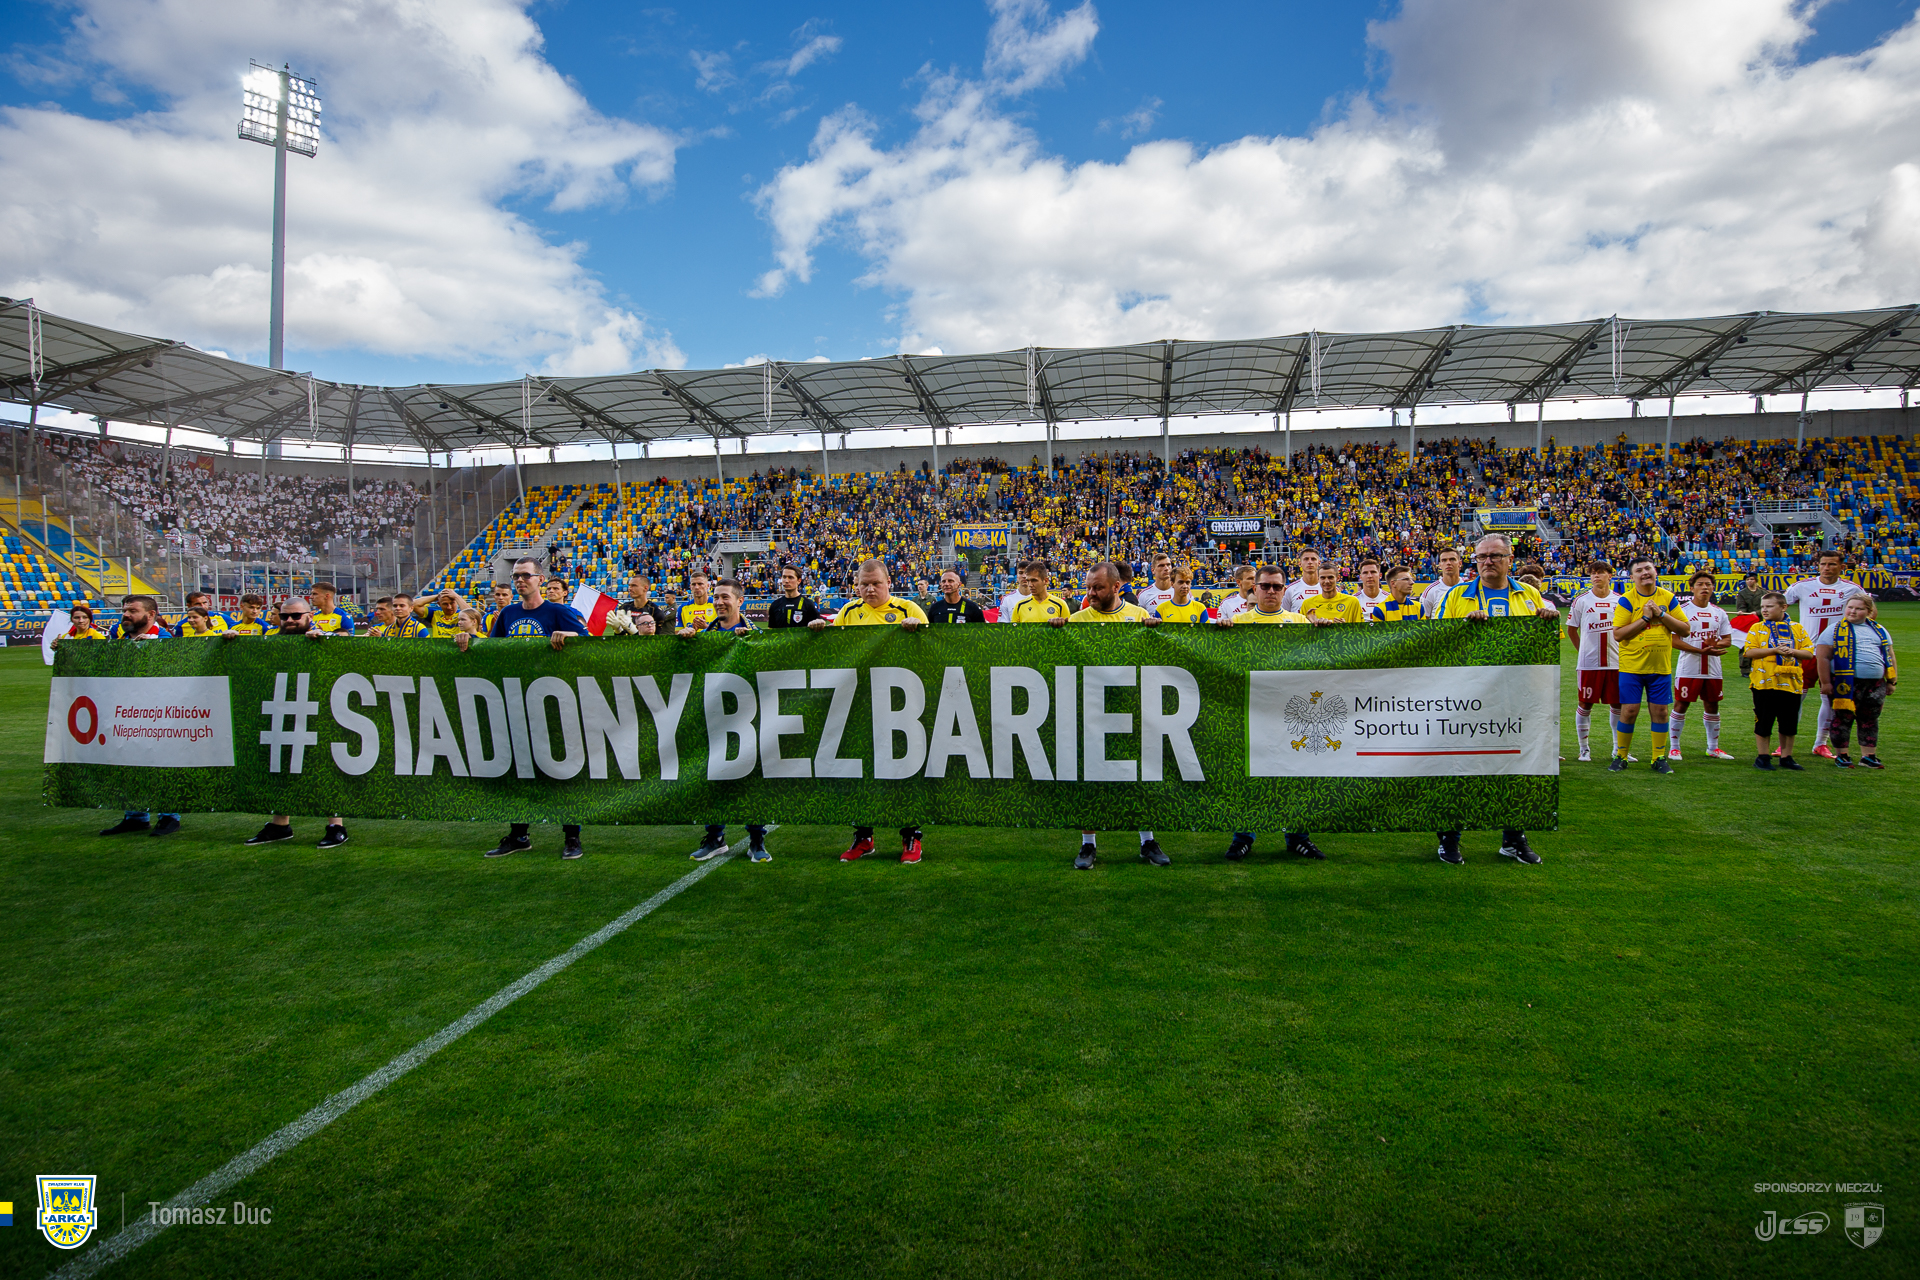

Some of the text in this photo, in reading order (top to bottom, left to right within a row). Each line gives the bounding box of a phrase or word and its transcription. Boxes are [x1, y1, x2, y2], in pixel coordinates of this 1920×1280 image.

[1211, 520, 1260, 532] GNIEWINO
[1809, 605, 1843, 615] Kramel
[16, 618, 49, 630] Ener
[1588, 620, 1614, 630] Kram
[1582, 686, 1593, 699] 19
[1681, 686, 1688, 698] 8
[1354, 696, 1482, 712] Ministerstwo
[115, 705, 211, 722] Federacja Kibiców
[113, 724, 214, 742] Niepełnosprawnych
[1354, 717, 1522, 739] Sportu i Turystyki
